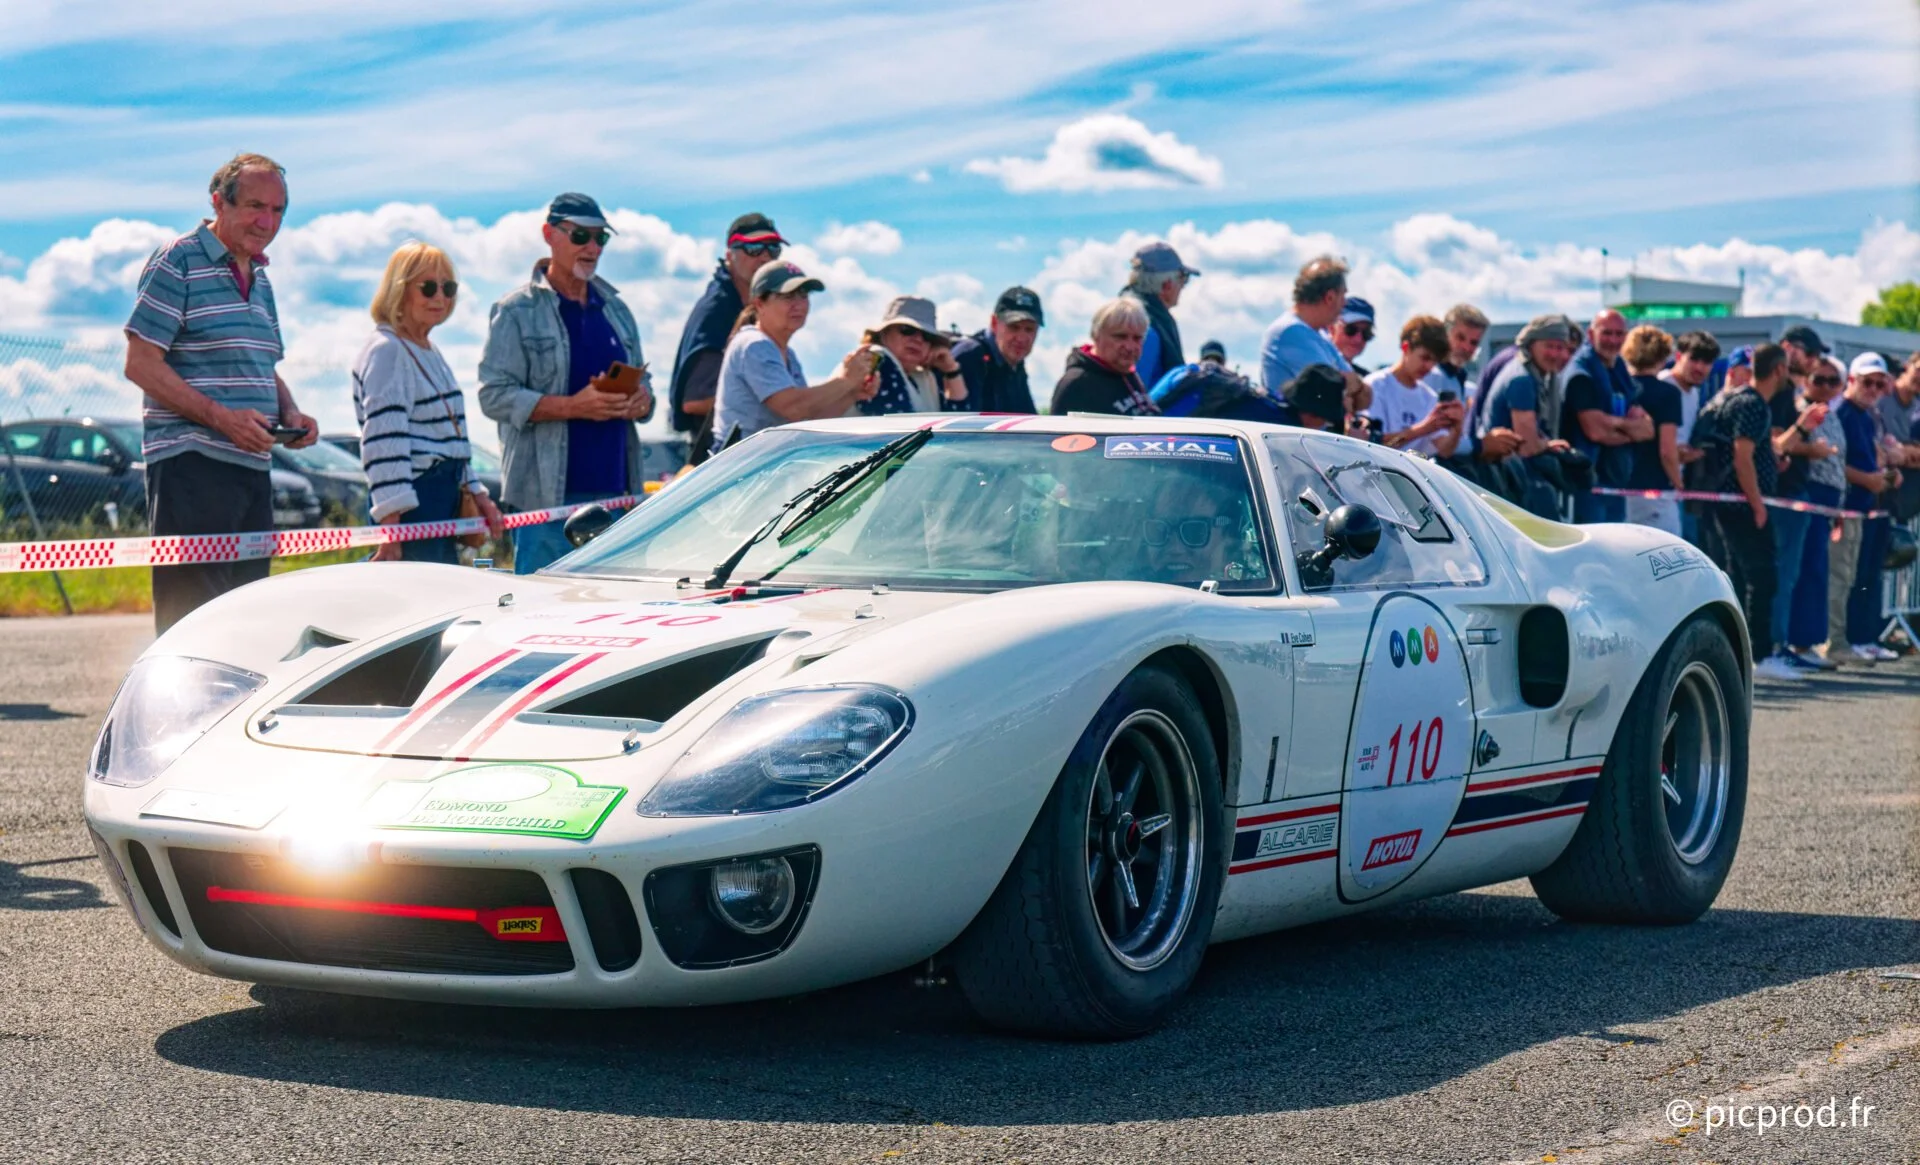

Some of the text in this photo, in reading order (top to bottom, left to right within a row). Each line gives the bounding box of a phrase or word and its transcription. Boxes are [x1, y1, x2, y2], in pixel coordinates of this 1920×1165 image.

[1110, 437, 1233, 457] AXIAL
[575, 613, 722, 626] 110
[1387, 716, 1443, 787] 110
[423, 800, 507, 813] EDMOND
[440, 814, 567, 829] ROTHSCHILD
[1257, 822, 1336, 853] ALCARIE
[1365, 834, 1417, 866] MOTUL
